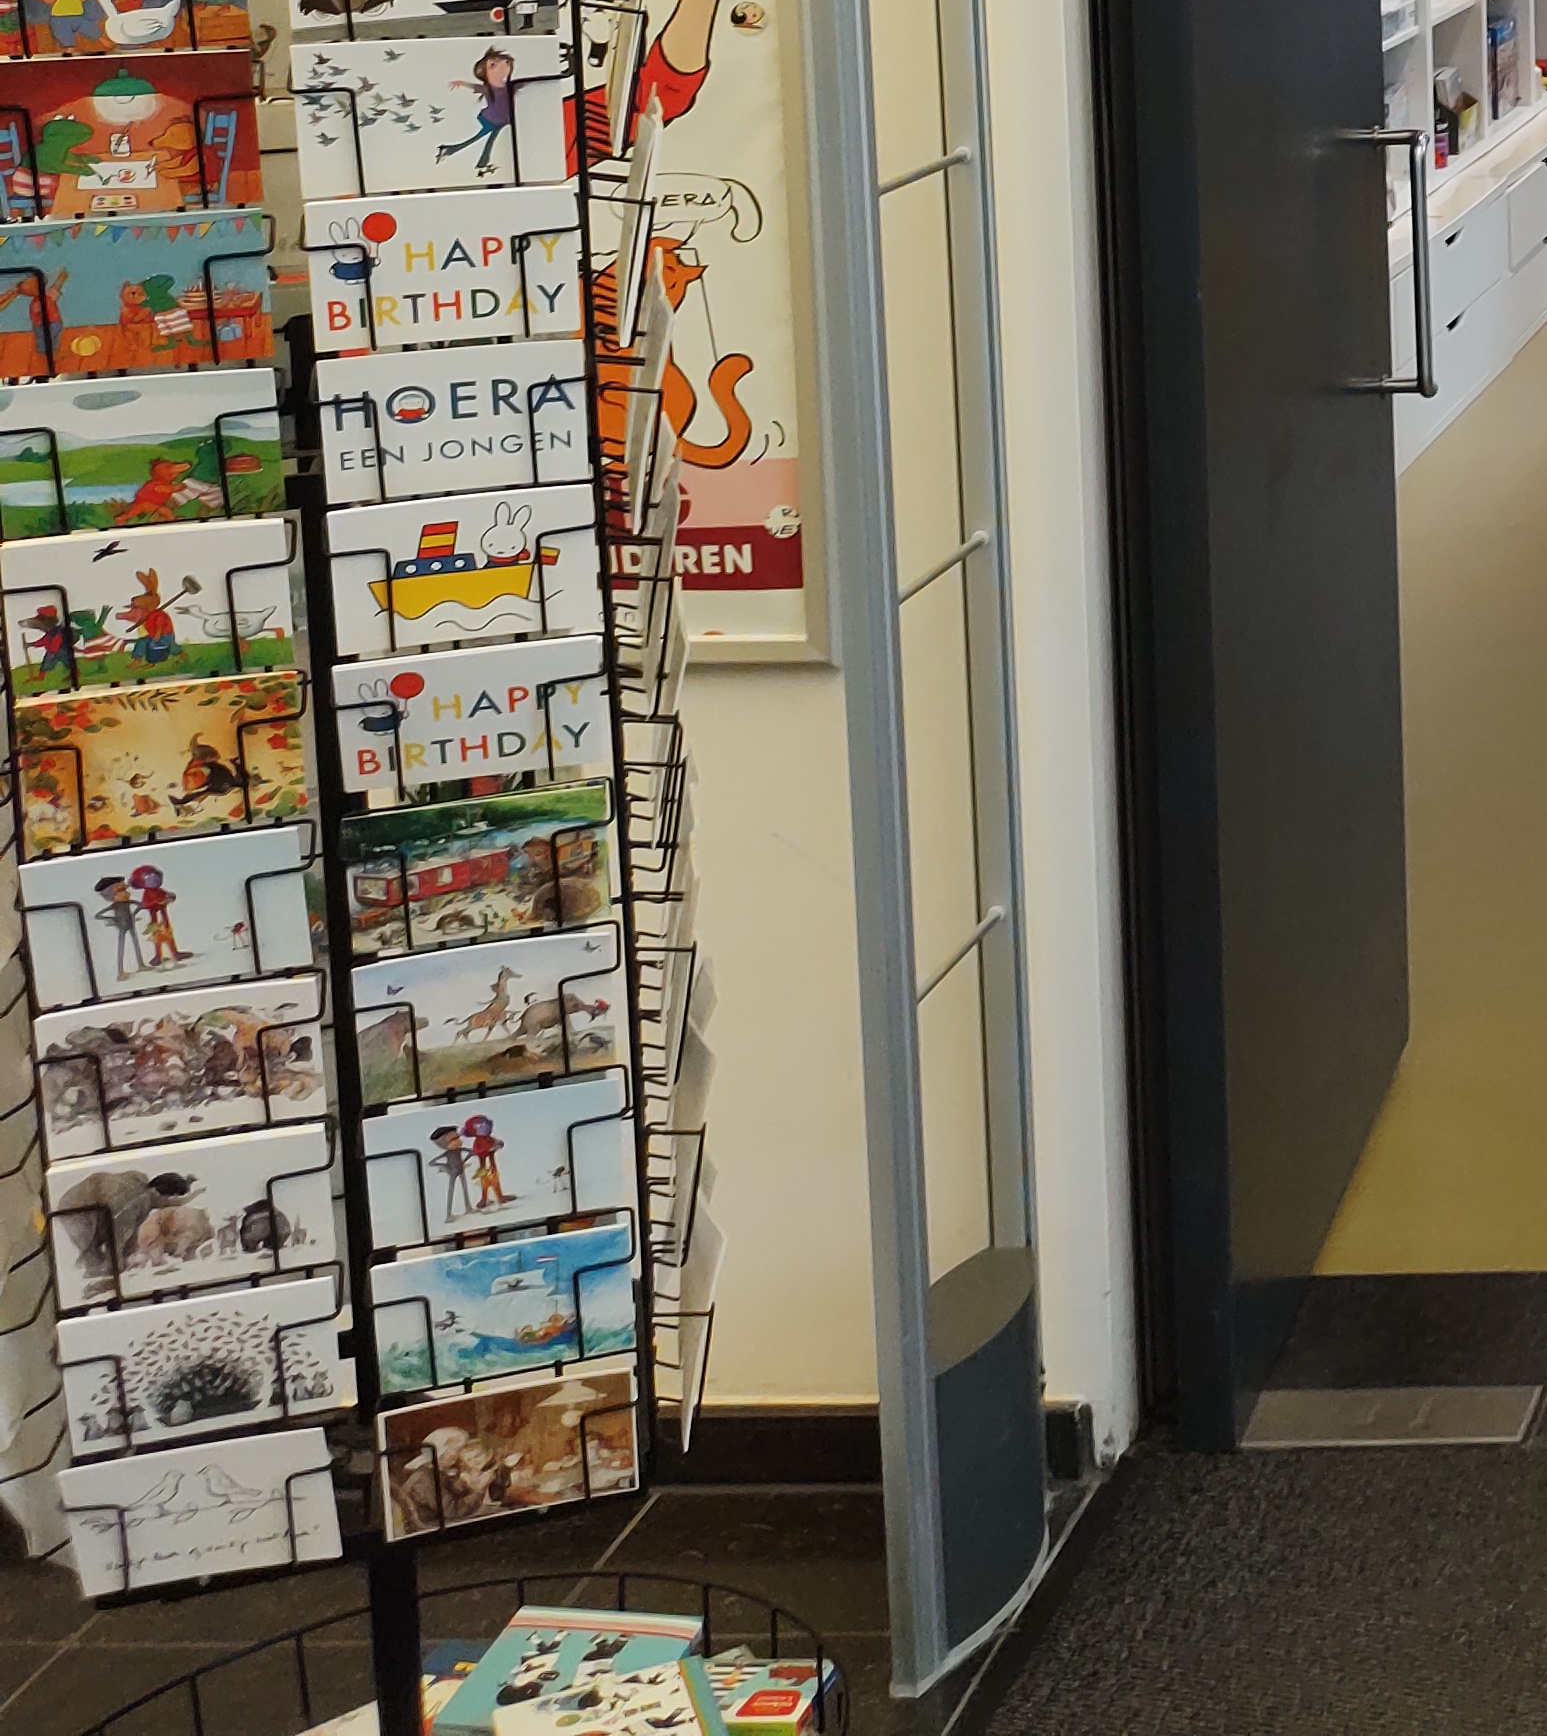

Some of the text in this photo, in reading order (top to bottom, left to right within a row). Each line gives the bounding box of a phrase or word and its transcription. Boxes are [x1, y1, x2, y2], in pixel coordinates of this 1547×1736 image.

[660, 186, 732, 209] ERA!
[403, 233, 562, 274] HAPPY
[326, 281, 567, 332] BIRTHDAY
[332, 372, 577, 433] HOERA
[339, 429, 573, 472] EEN JONGEN
[431, 681, 584, 723] HAPPY
[356, 720, 591, 776] BIRTHDAY
